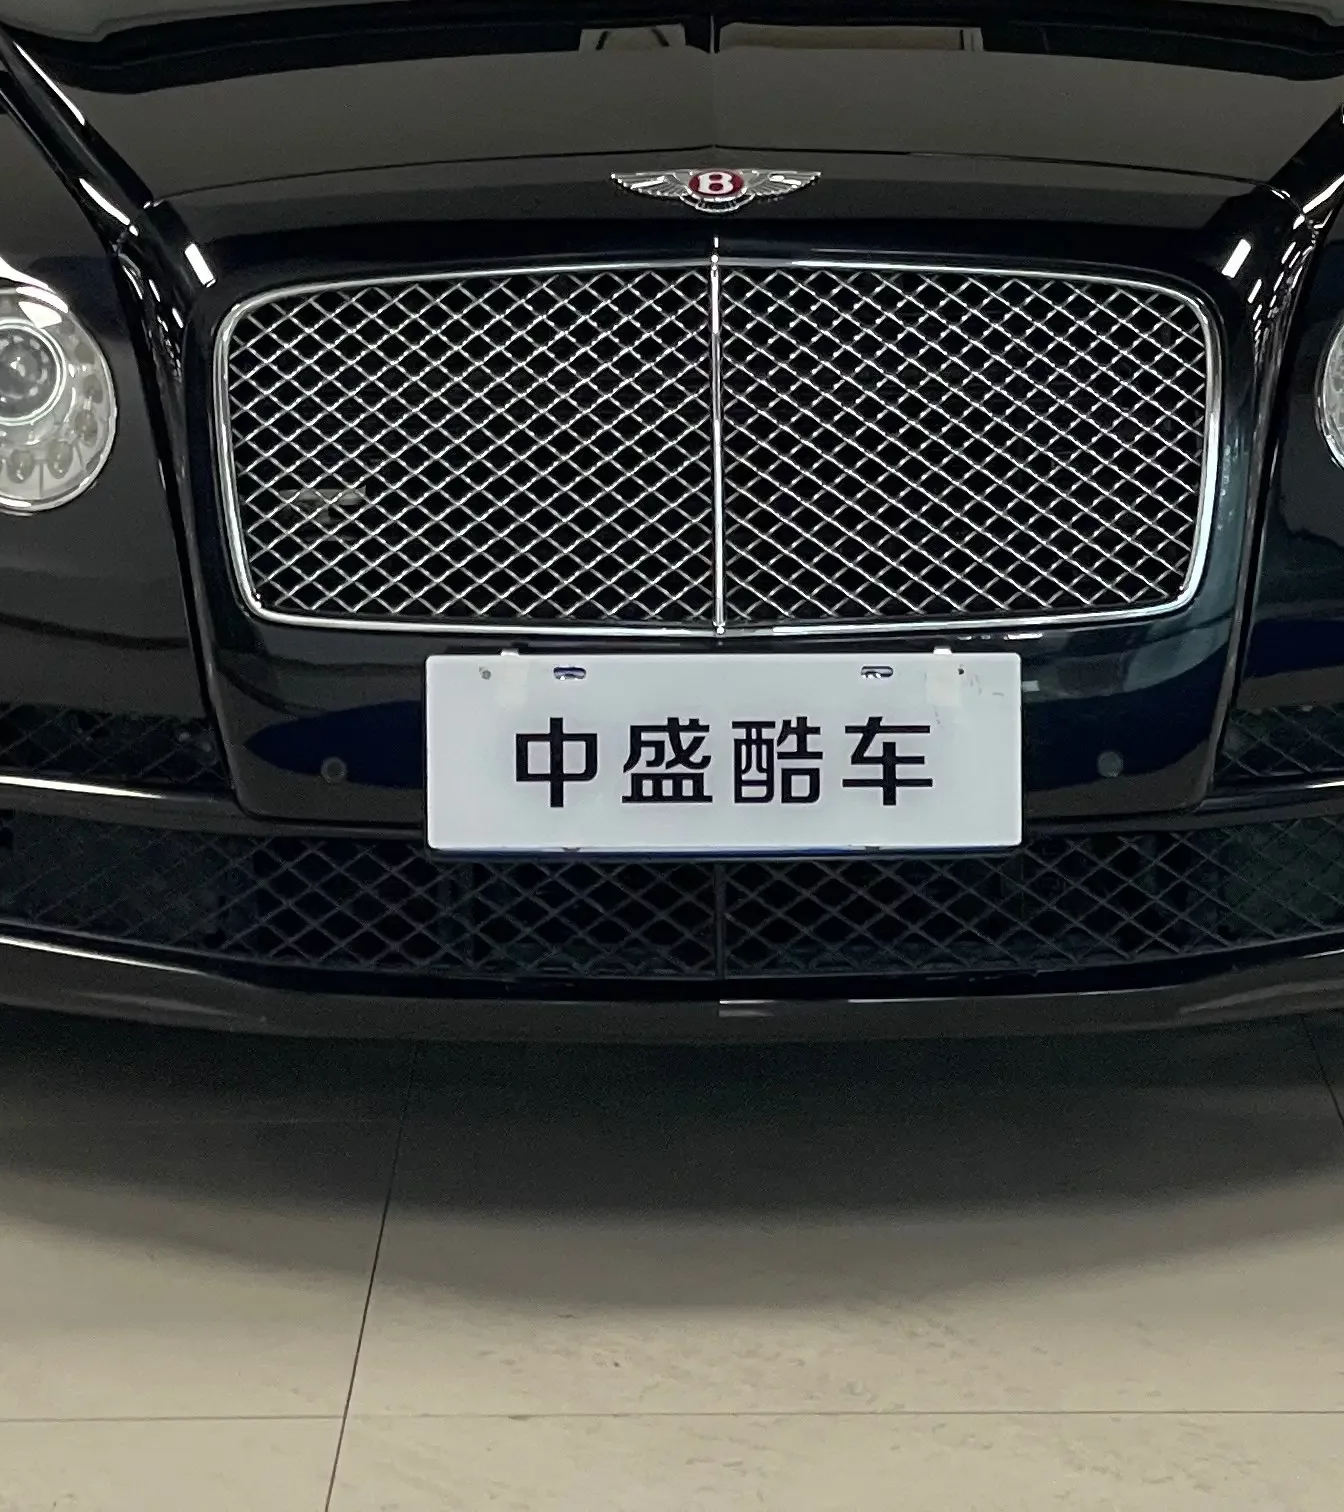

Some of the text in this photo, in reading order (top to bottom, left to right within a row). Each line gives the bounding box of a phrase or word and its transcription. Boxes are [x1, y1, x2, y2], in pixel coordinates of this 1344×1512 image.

[697, 171, 736, 195] B
[514, 715, 934, 808] 中盛酷车
